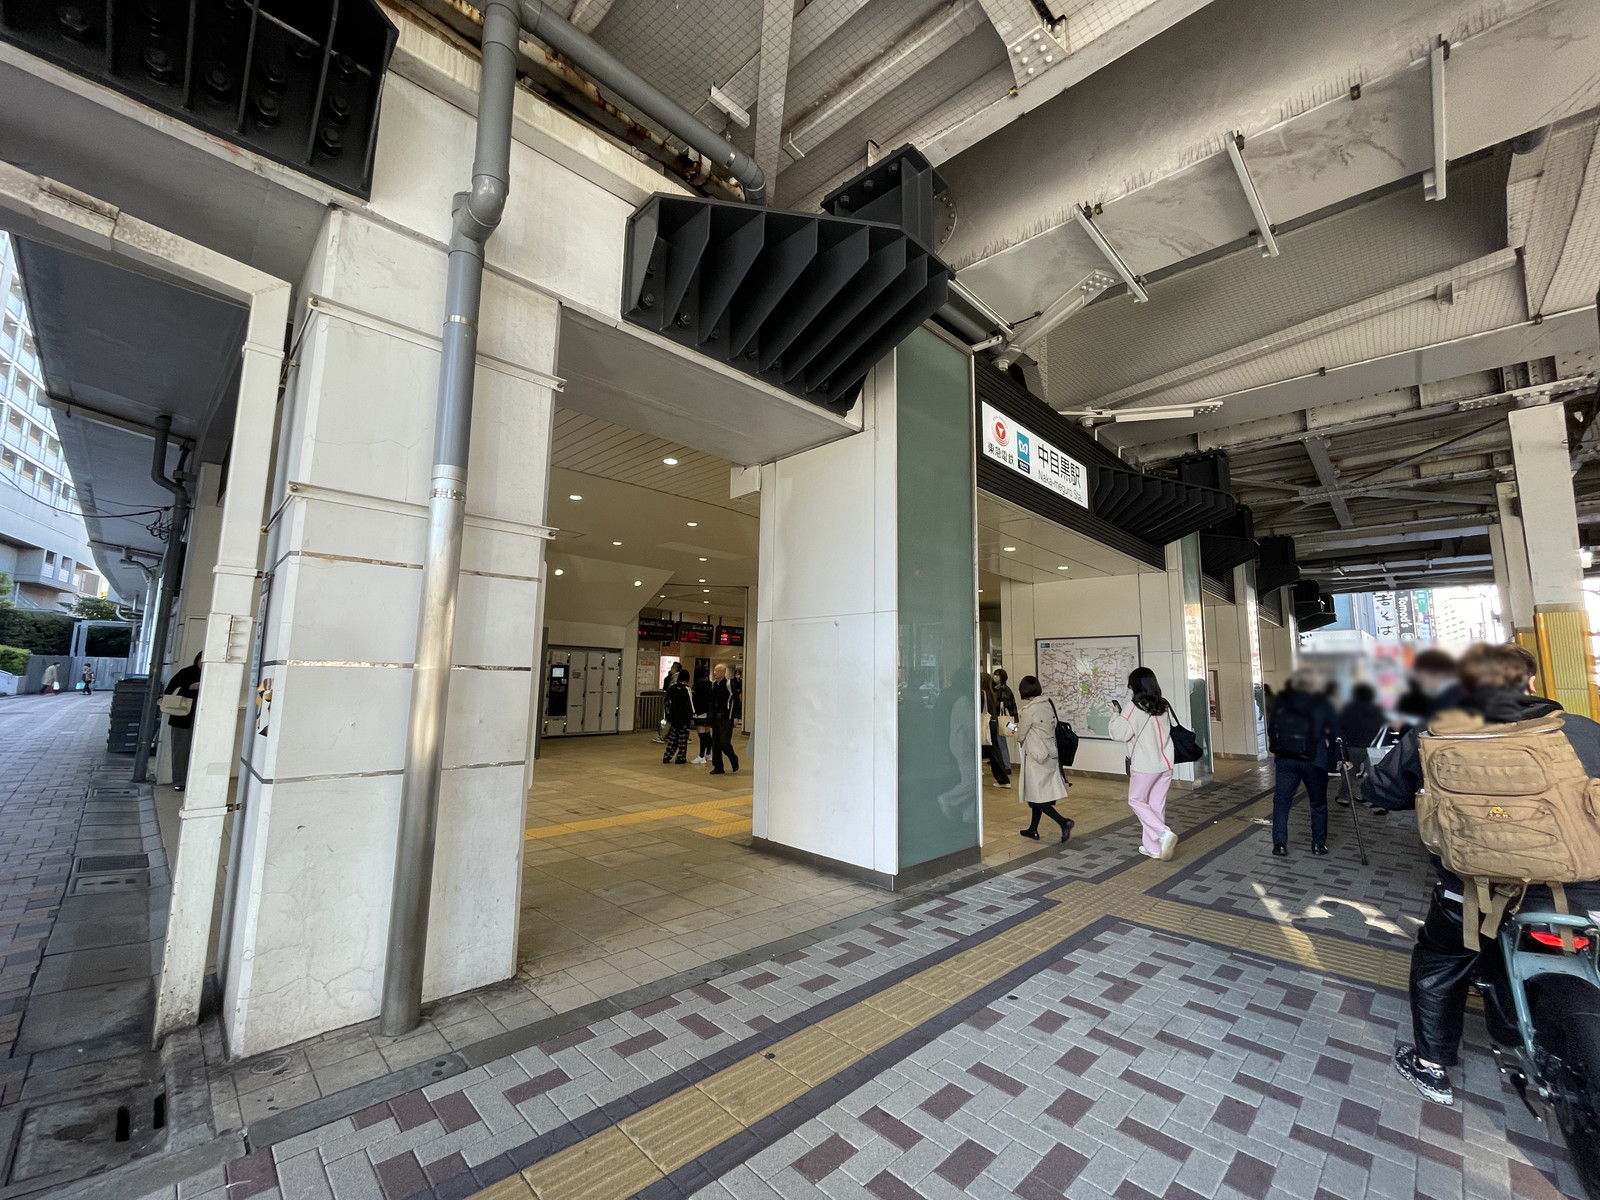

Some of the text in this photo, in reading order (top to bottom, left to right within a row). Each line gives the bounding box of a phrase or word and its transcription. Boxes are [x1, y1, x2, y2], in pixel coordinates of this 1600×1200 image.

[988, 442, 1014, 466] 東急電鉄
[1038, 444, 1081, 489] 中目黒駅
[1038, 469, 1083, 502] Naka-meguro Sta.
[1398, 596, 1412, 629] Tomod's
